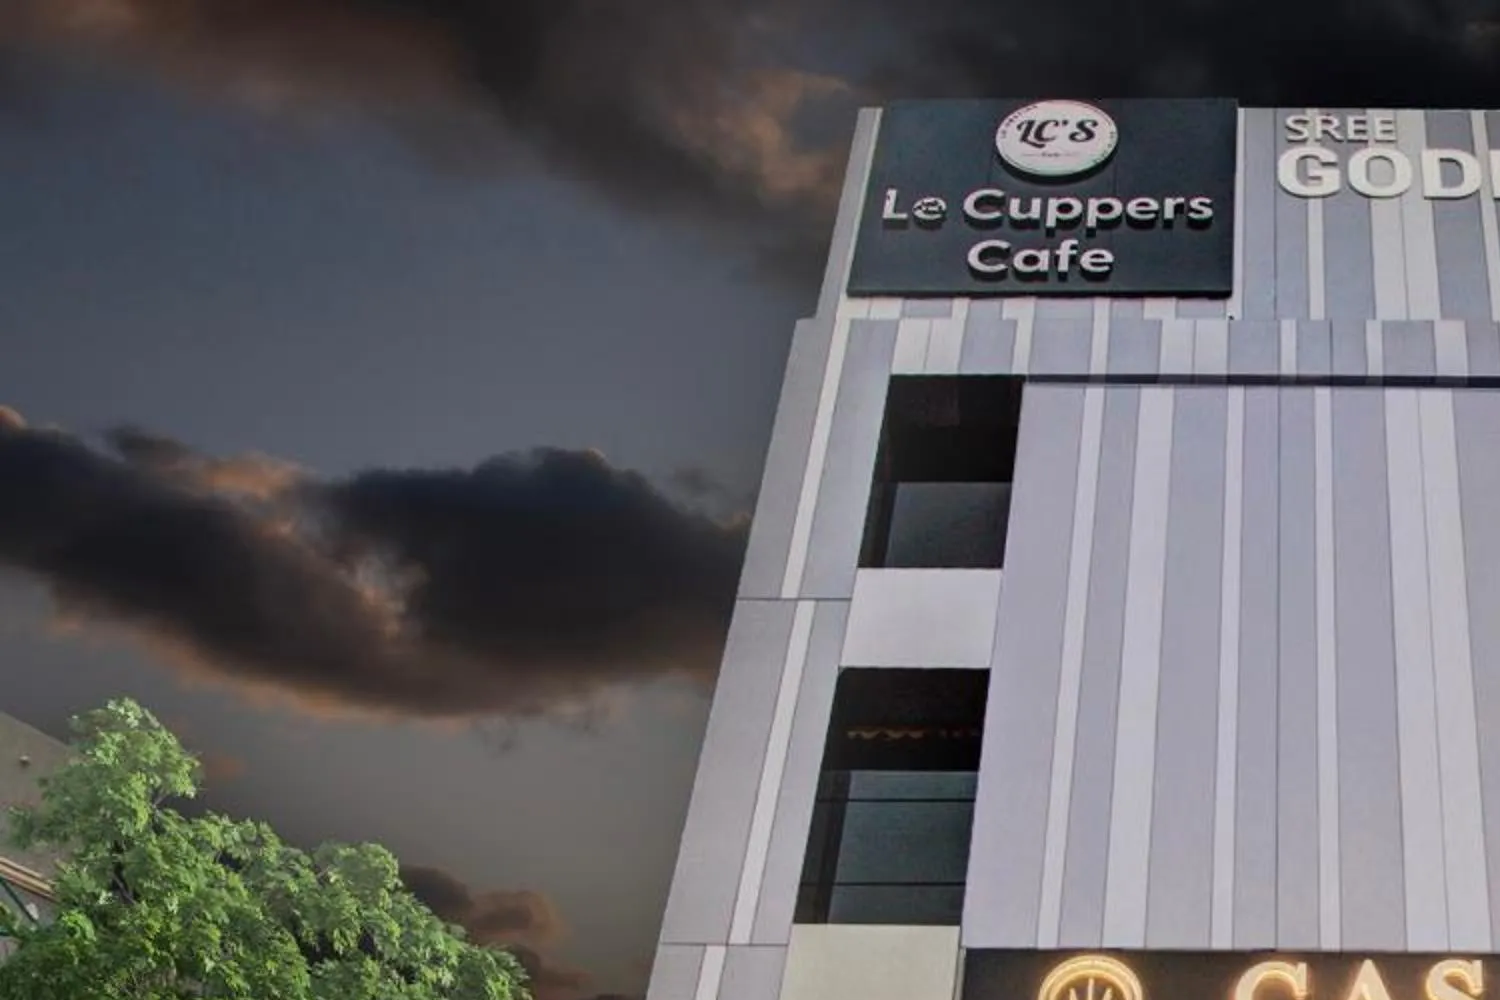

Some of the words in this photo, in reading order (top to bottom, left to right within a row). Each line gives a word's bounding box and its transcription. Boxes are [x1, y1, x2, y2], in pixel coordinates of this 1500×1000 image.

[1285, 113, 1398, 143] SREE
[882, 188, 948, 221] Le
[963, 188, 1213, 229] Cuppers
[967, 239, 1114, 273] Cafe
